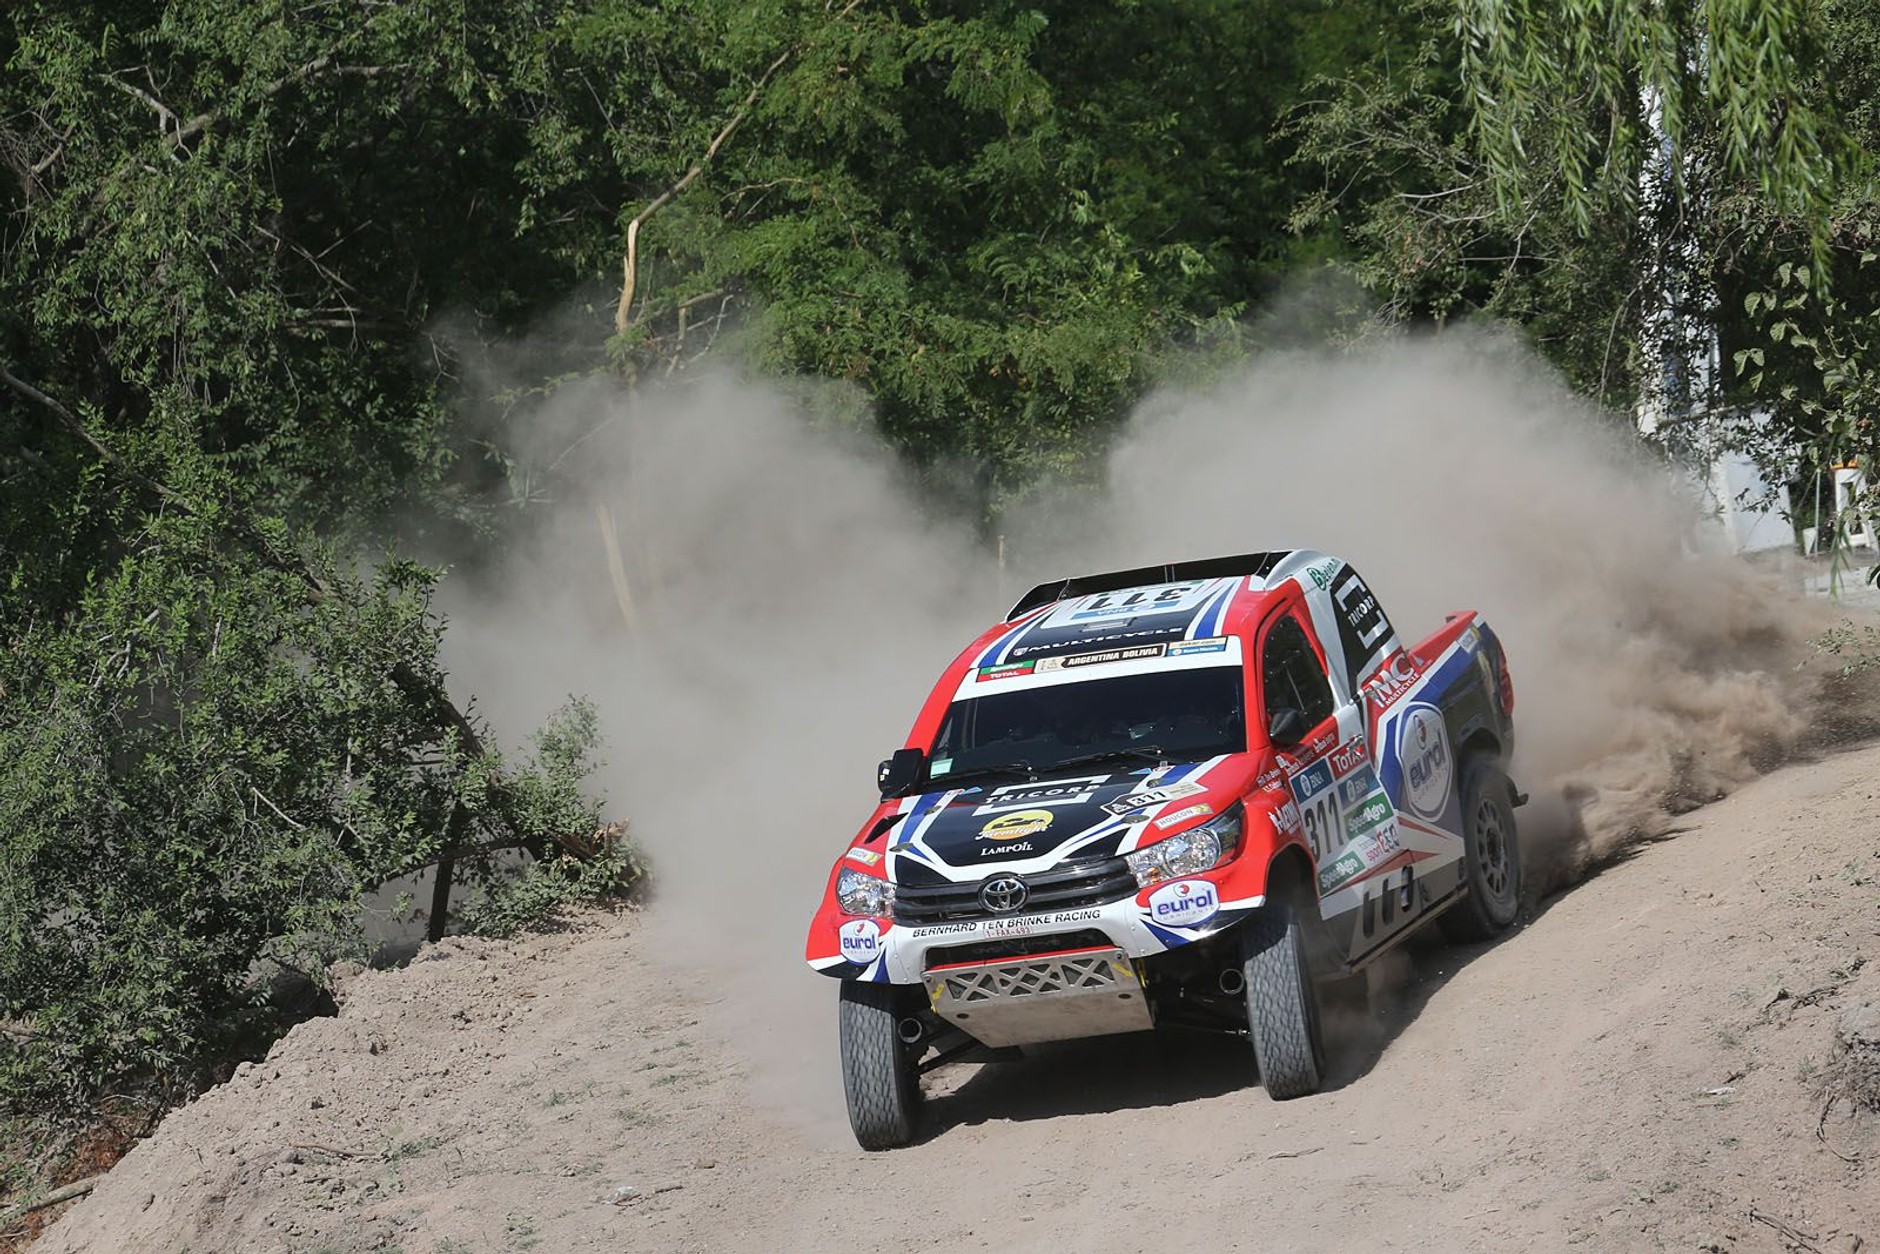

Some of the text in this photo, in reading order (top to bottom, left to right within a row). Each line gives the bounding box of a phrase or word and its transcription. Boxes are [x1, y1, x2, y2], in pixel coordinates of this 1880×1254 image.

[1089, 586, 1191, 611] 311
[1347, 595, 1375, 627] TRICORP
[1027, 627, 1183, 651] MULTICYCLE
[1067, 651, 1120, 667] ARGENTINA
[1122, 647, 1158, 660] BOLIVIA
[989, 671, 1020, 679] TOTAL
[1384, 673, 1420, 706] MULTICYCLE
[1410, 729, 1446, 789] eurol
[984, 784, 1101, 805] TRICORP
[1131, 791, 1166, 804] 311
[1304, 792, 1344, 864] 311
[1157, 890, 1213, 915] eurol
[912, 922, 977, 938] BERNHARD
[1007, 915, 1052, 928] BRINKE
[1053, 910, 1101, 923] RACING
[843, 934, 876, 949] eurol
